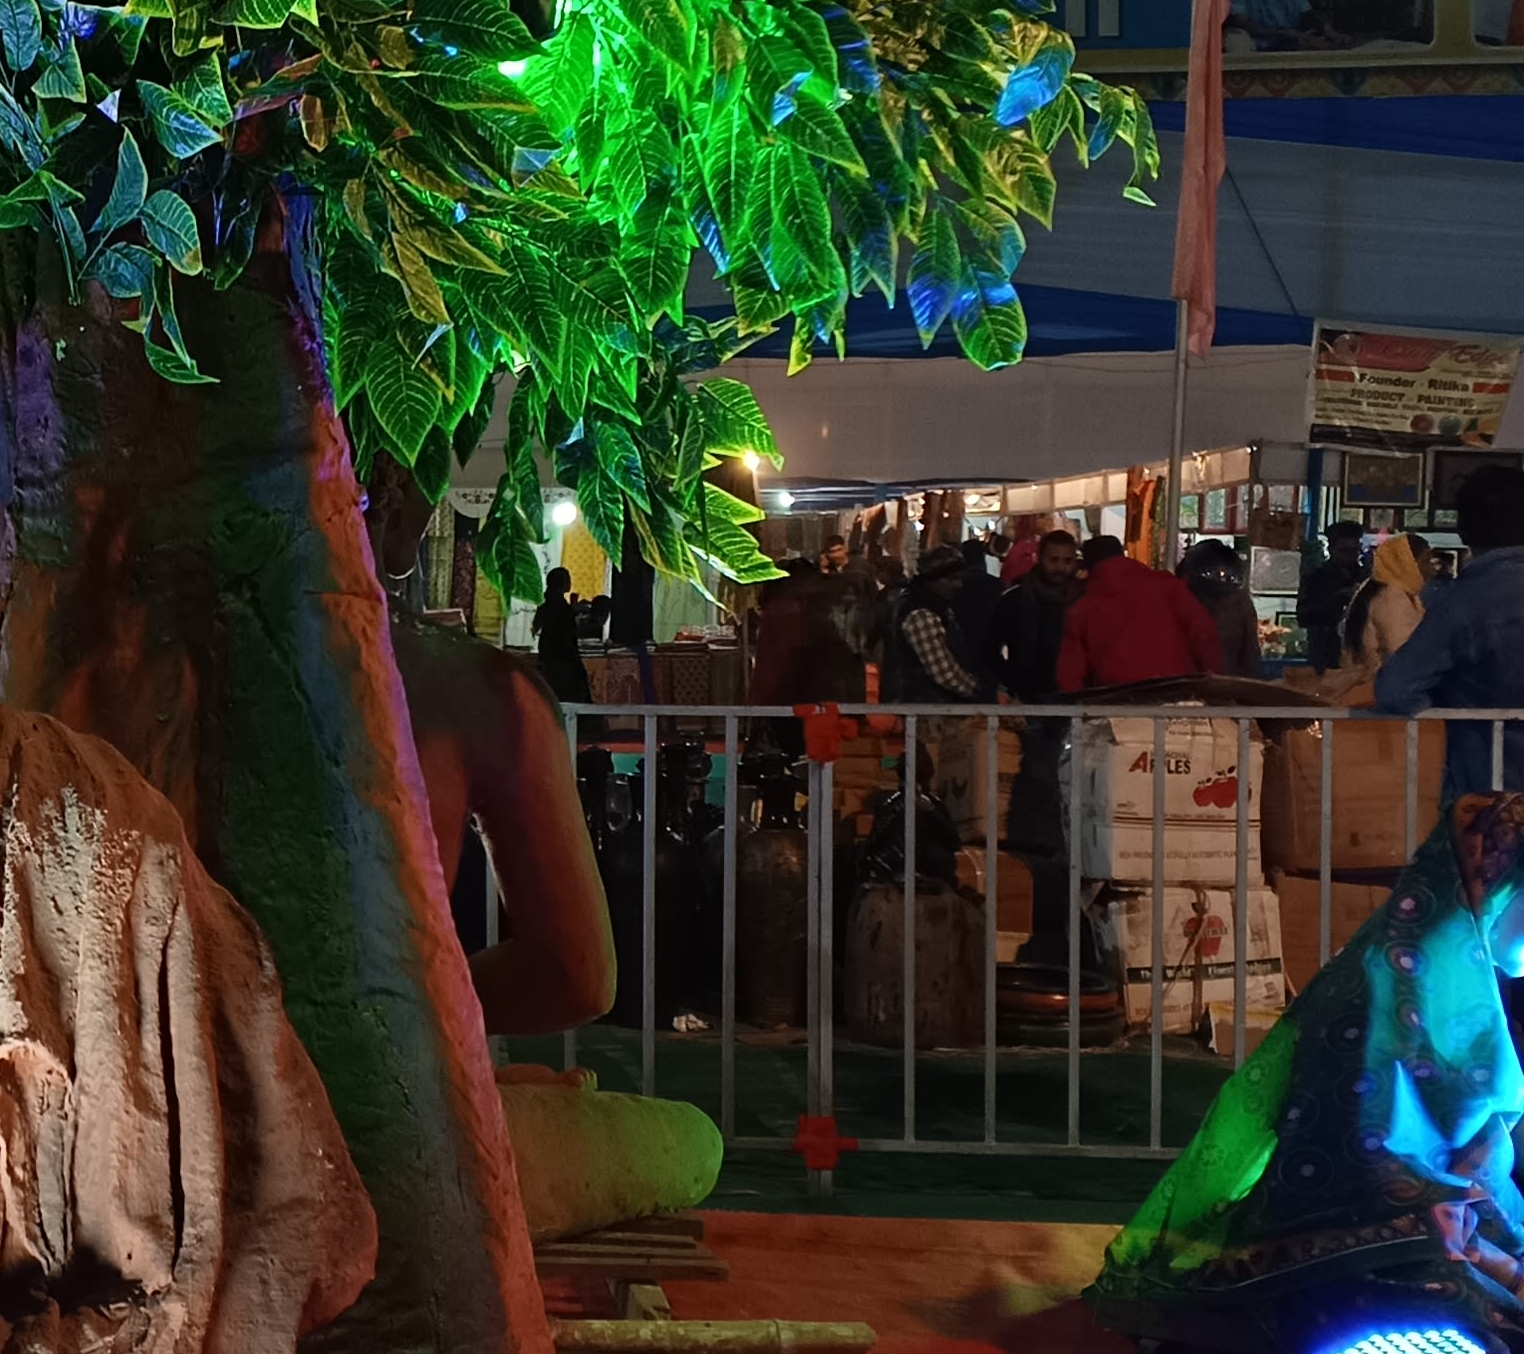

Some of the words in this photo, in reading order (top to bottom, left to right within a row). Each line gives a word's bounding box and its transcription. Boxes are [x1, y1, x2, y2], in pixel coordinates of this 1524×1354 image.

[1359, 372, 1416, 389] Founder
[1427, 378, 1470, 393] Ritika
[1350, 387, 1406, 403] PRODUCT
